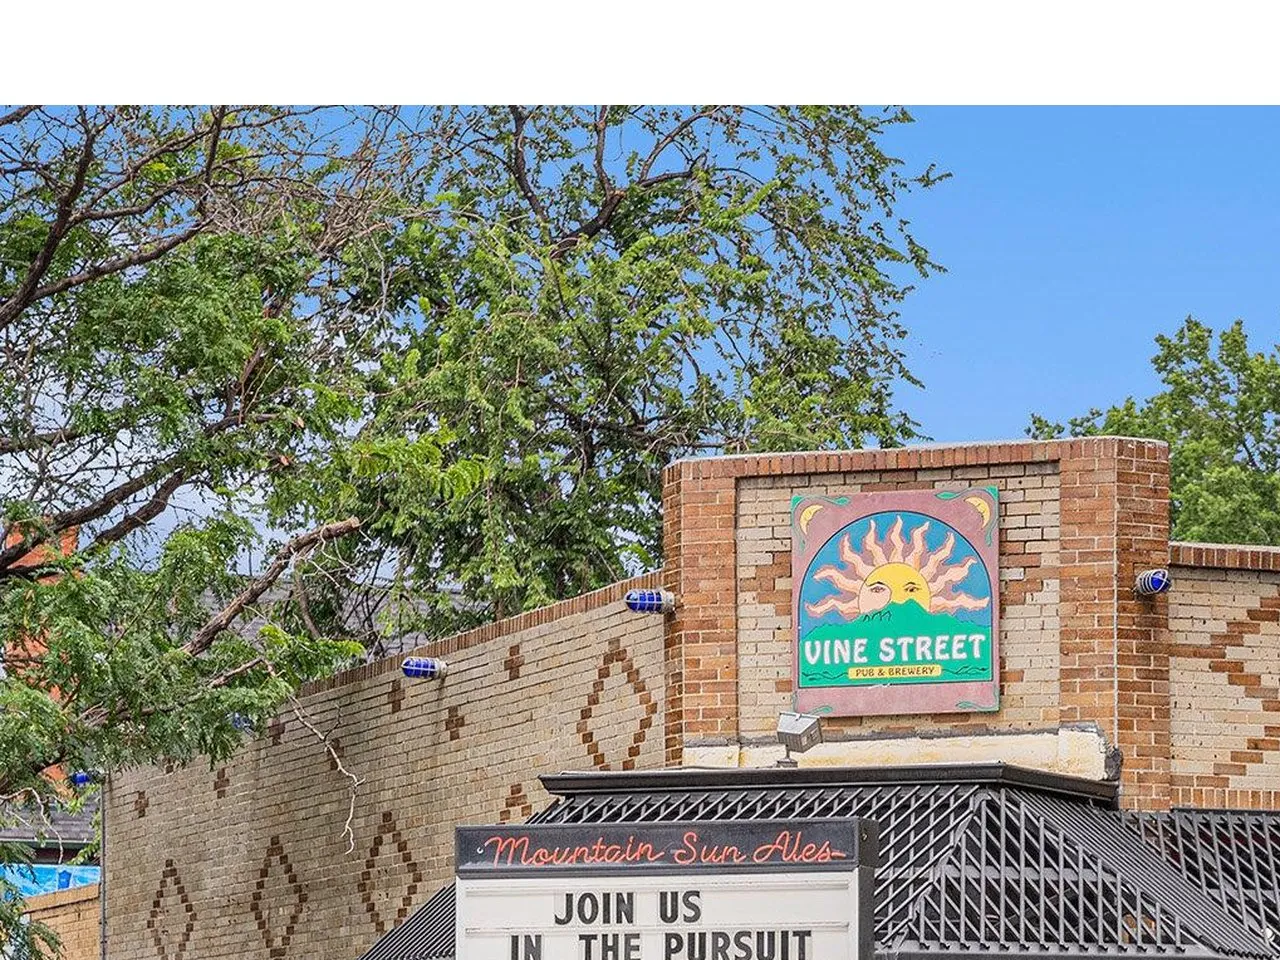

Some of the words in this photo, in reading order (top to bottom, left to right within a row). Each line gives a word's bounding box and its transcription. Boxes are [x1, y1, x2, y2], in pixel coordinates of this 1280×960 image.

[804, 638, 868, 665] VINE
[879, 634, 986, 662] STREET
[855, 667, 874, 677] PUB
[877, 667, 886, 677] &
[888, 666, 935, 676] BREWERY
[484, 834, 664, 868] Mountain
[675, 832, 747, 865] Sun
[554, 891, 634, 925] JOIN
[659, 890, 702, 924] US
